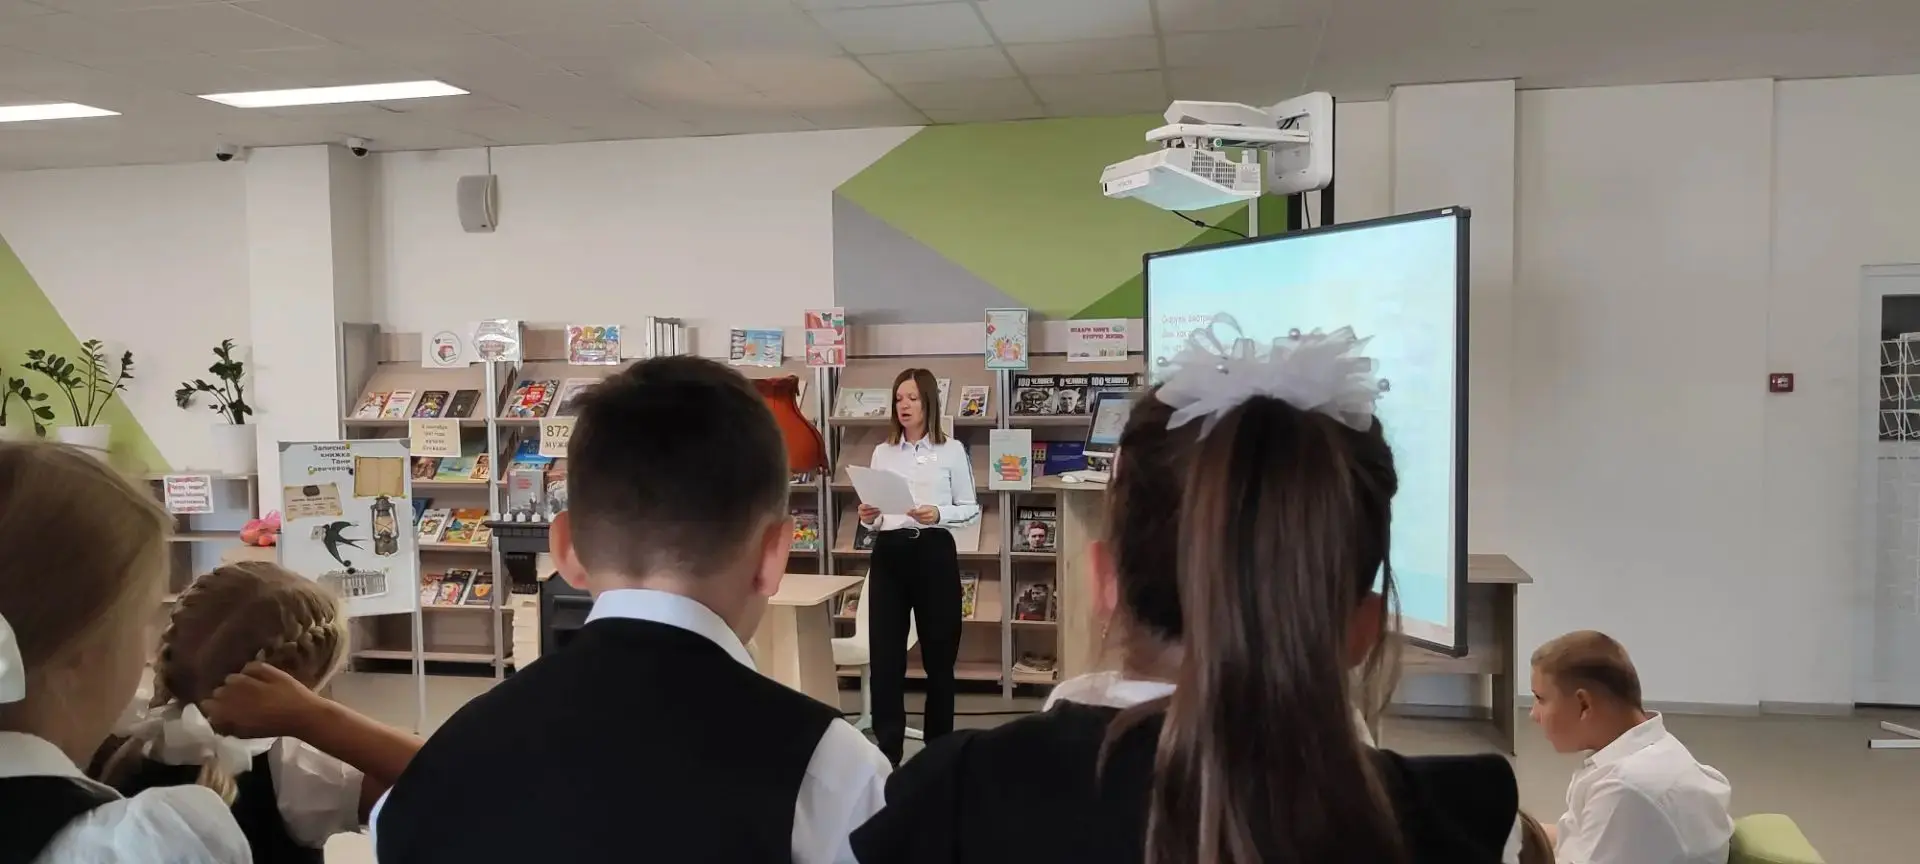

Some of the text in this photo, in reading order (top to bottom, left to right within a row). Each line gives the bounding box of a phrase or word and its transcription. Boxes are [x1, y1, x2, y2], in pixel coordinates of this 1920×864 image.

[570, 326, 619, 343] 2026
[1018, 377, 1031, 387] 100
[1091, 376, 1104, 386] 100
[546, 425, 569, 437] 872
[1020, 509, 1033, 519] 100
